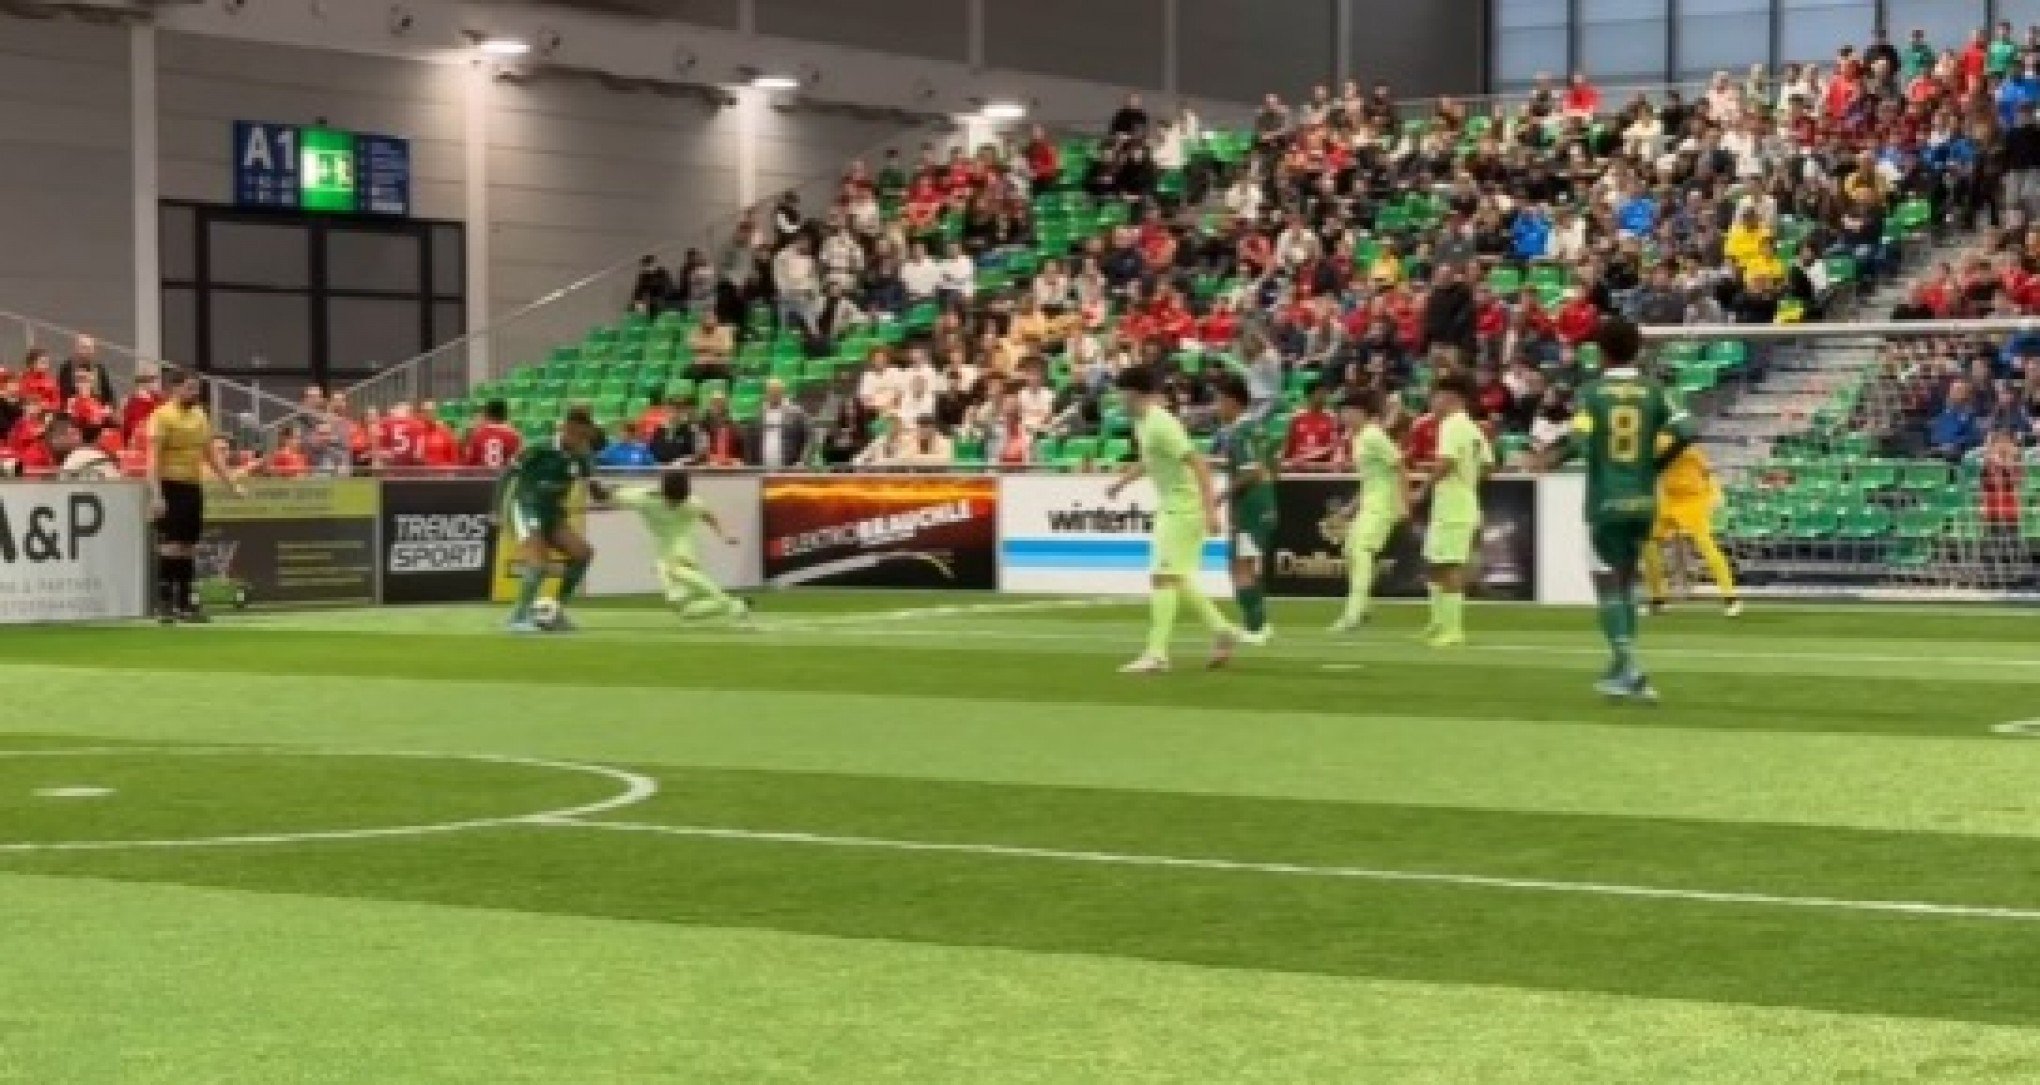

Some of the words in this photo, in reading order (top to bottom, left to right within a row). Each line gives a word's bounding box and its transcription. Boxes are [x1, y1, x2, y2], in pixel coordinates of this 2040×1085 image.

[243, 127, 294, 170] A1
[1608, 405, 1640, 462] 8
[485, 439, 504, 467] 8
[395, 514, 487, 541] TRENDS
[394, 544, 484, 569] SPORT
